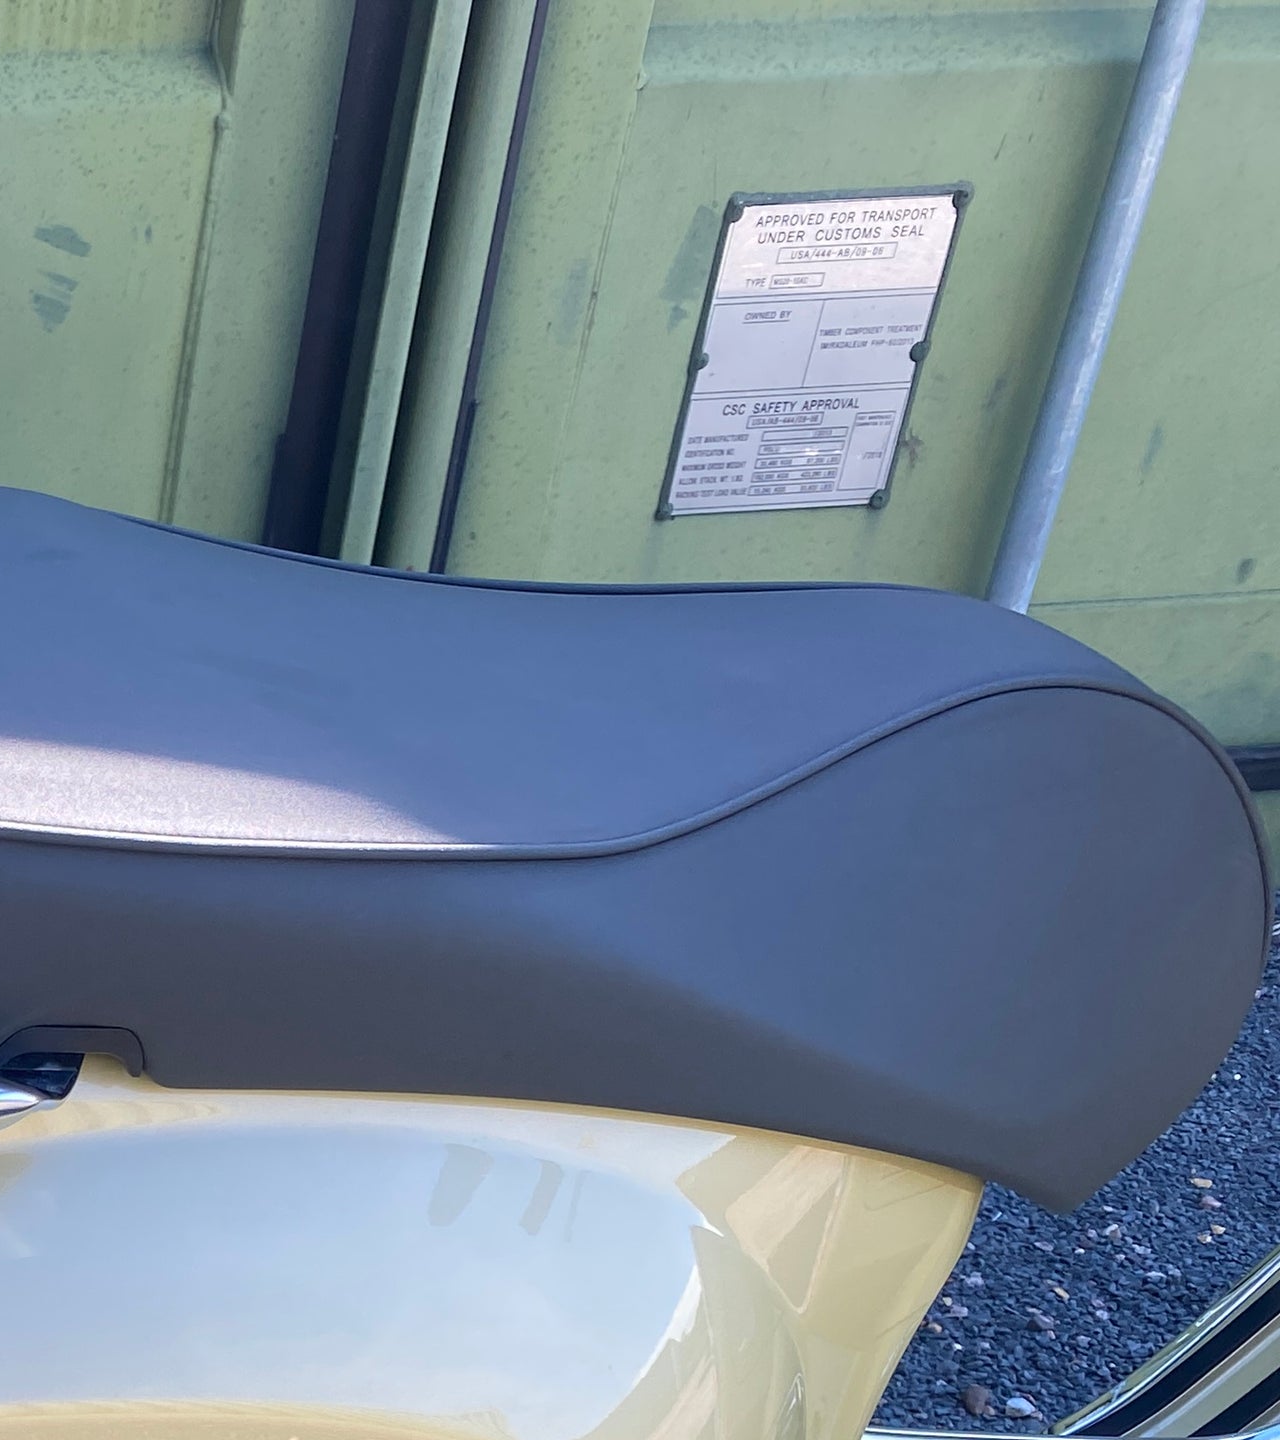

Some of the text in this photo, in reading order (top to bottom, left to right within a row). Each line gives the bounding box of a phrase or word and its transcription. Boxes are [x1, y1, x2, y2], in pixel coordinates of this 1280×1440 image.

[756, 208, 936, 227] APPROVED FOR TRANSPORT
[757, 225, 925, 243] UNDER CUSTOMS SEAL
[745, 278, 765, 287] TYPE
[745, 310, 791, 319] OWNED BY
[723, 398, 860, 415] CSC SAFETY APPROVAL
